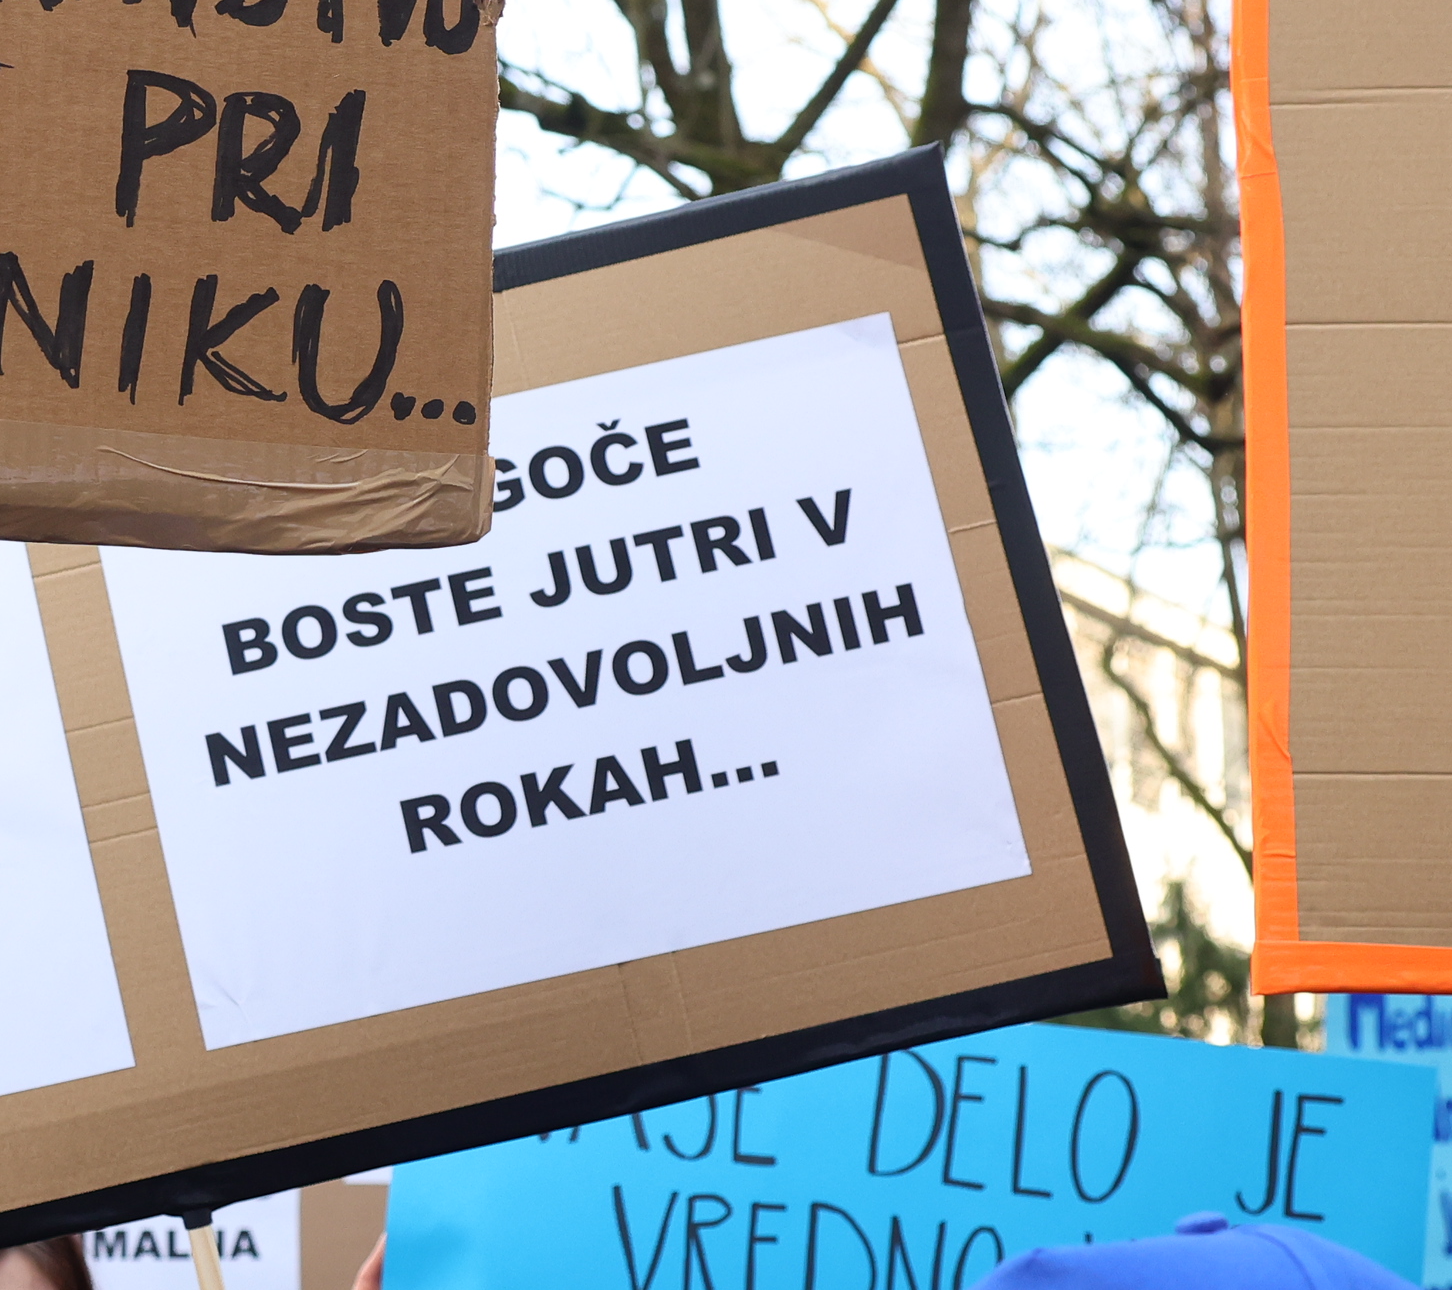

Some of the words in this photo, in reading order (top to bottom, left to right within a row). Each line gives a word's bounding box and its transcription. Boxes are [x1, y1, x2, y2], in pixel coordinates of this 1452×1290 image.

[113, 68, 365, 234] PRI
[493, 418, 700, 513] GOČE
[222, 567, 503, 675] BOSTE
[529, 506, 778, 609] JUTRI
[796, 488, 854, 549] V
[204, 582, 925, 787] NEZADOVOLJNIH
[399, 738, 780, 854] ROKAH...
[867, 1050, 1140, 1205] DELO
[1235, 1089, 1345, 1223] JE
